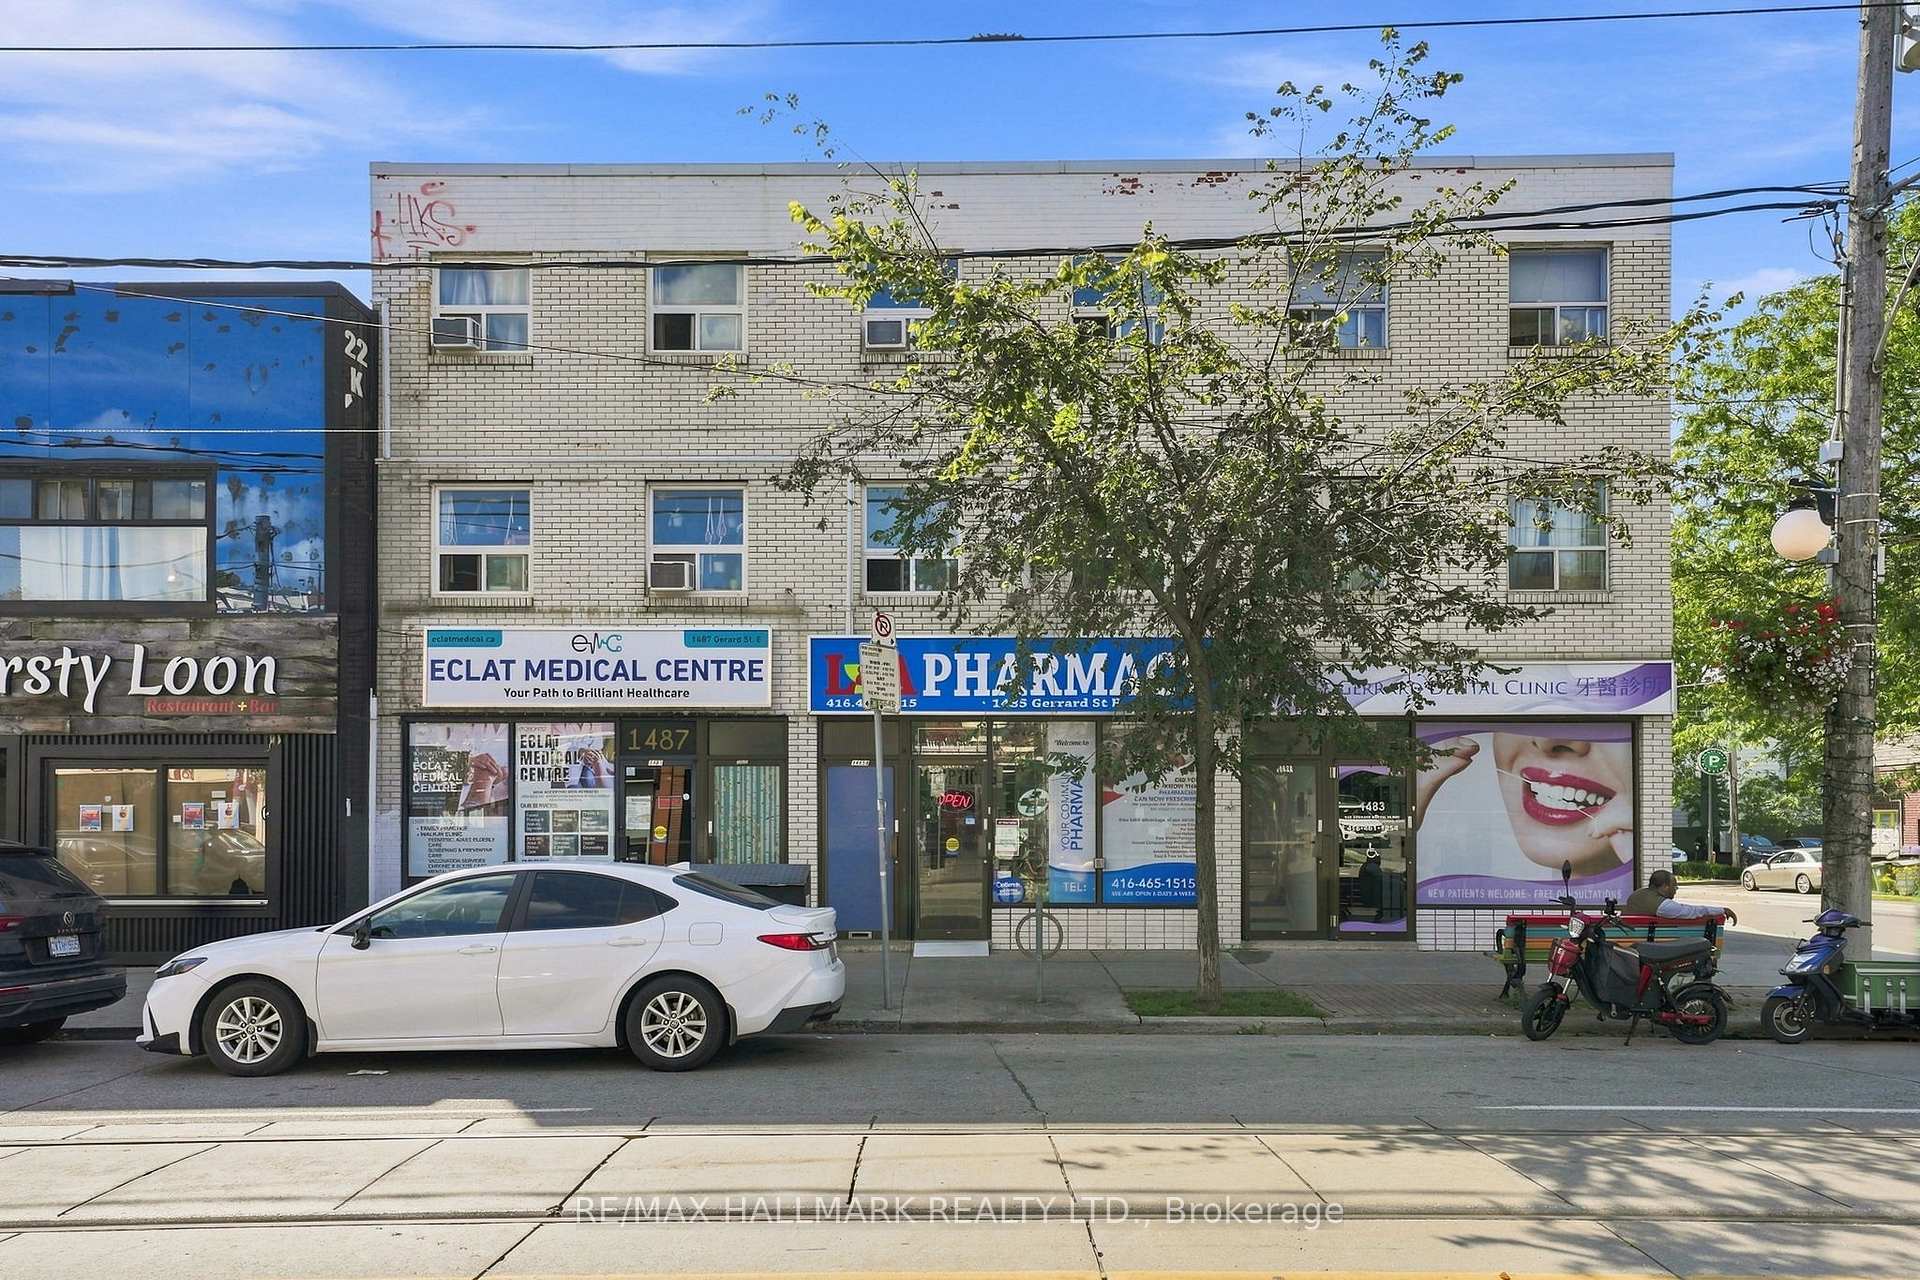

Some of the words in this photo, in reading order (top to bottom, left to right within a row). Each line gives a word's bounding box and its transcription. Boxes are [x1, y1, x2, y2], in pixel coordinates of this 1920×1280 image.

[128, 643, 277, 696] Loon
[430, 659, 516, 681] ECLAT
[525, 659, 647, 681] MEDICAL
[655, 659, 764, 681] CENTRE
[923, 651, 1196, 697] PHARMAC
[504, 687, 529, 698] Your
[533, 687, 559, 698] Path
[562, 688, 574, 698] to
[577, 687, 623, 698] Brilliant
[627, 687, 690, 698] Healthcare
[1340, 680, 1424, 695] GERRRD
[1504, 679, 1568, 695] CLINIC
[147, 700, 234, 713] Restaurant
[250, 700, 278, 713] Bar
[1032, 698, 1088, 708] Gerrard
[1092, 698, 1109, 708] St
[520, 734, 560, 750] ECLAT
[628, 728, 690, 751] 1487
[520, 767, 570, 782] CENTRE
[412, 783, 457, 793] CENTRE
[938, 793, 971, 808] OPEN
[1360, 801, 1385, 811] 1483
[1070, 779, 1083, 850] PHARMA
[1060, 822, 1070, 851] YOUR
[1111, 877, 1196, 889] 416-465-1515
[1427, 888, 1444, 898] NEW
[1447, 888, 1485, 898] PATIENTS
